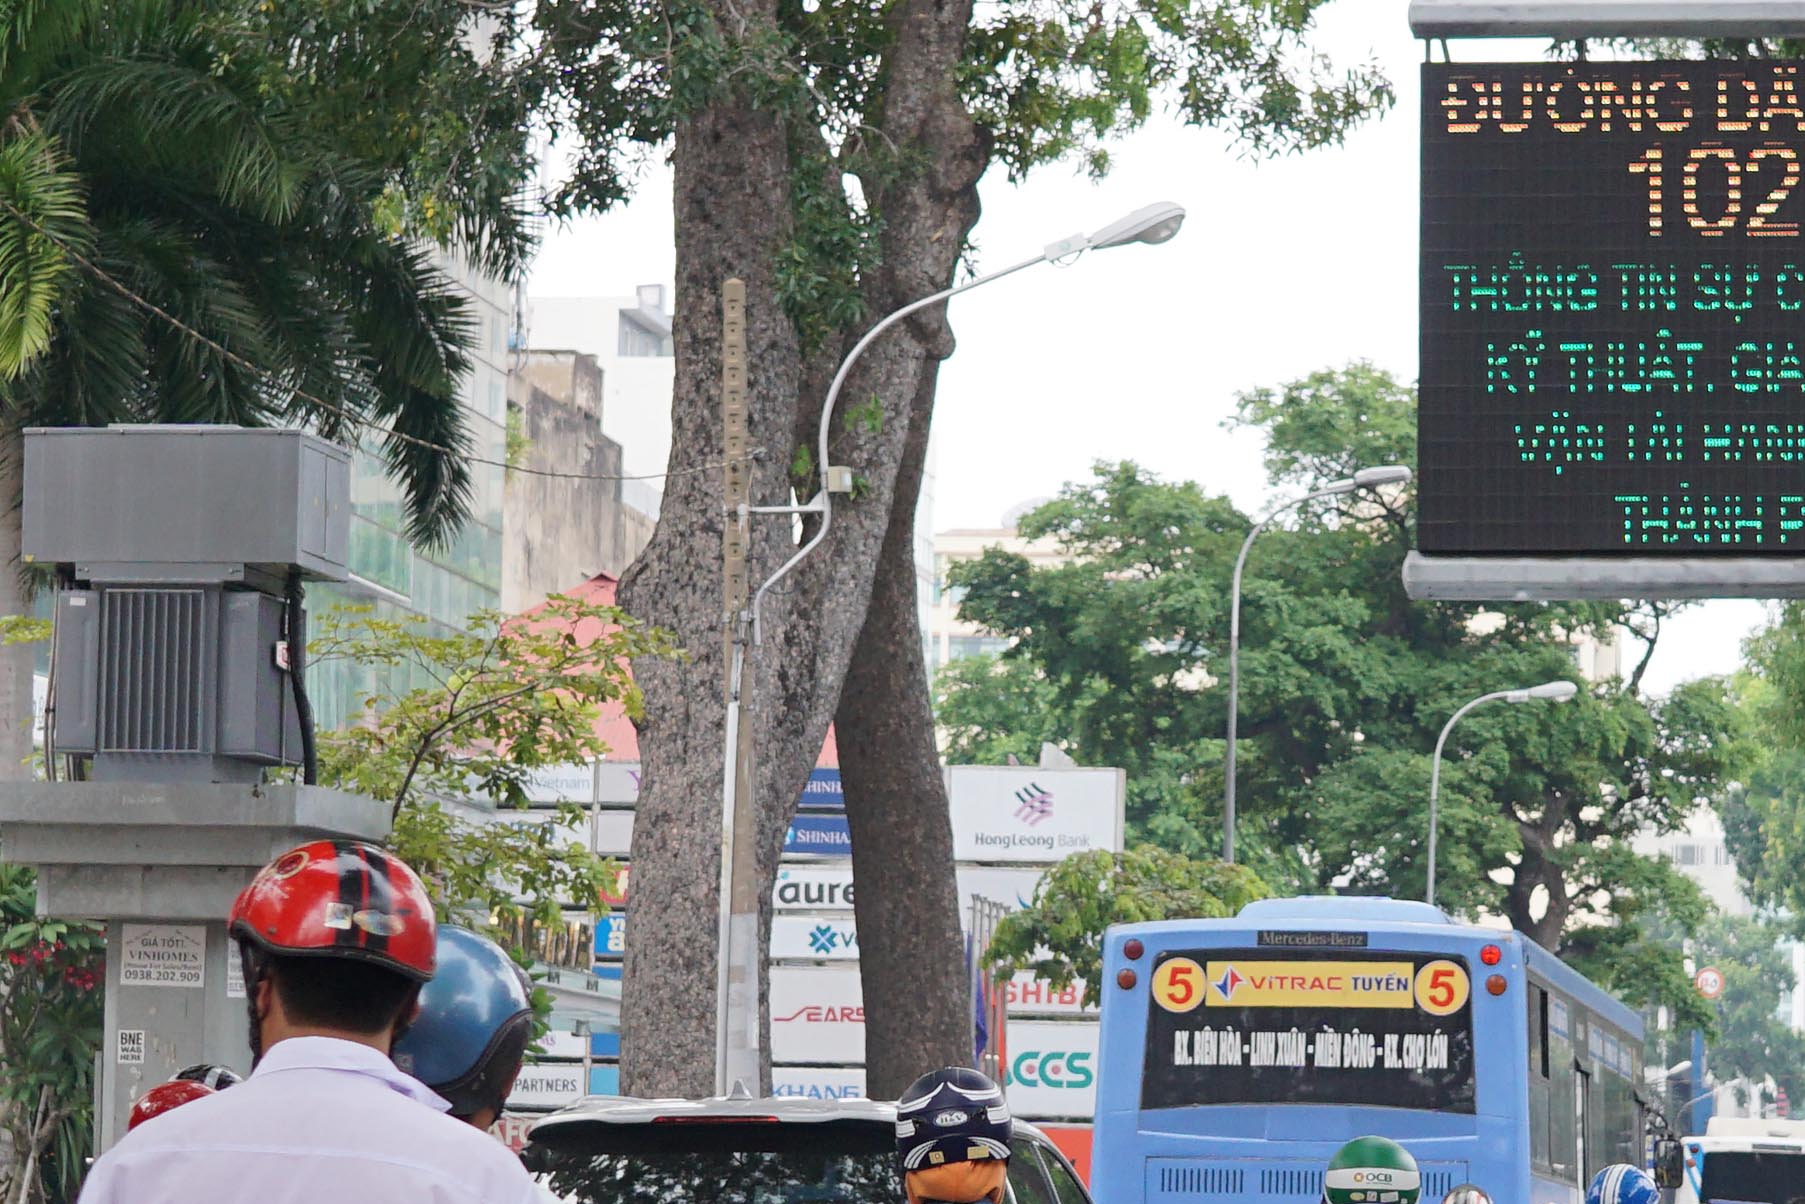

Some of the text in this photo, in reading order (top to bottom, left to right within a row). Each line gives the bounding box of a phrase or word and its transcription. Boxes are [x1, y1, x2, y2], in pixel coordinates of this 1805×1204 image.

[1612, 264, 1676, 311] TIN
[797, 829, 851, 844] SHINHA
[1058, 833, 1090, 847] Bank
[129, 950, 198, 961] VINHOMES
[124, 969, 200, 982] 0938.202.909
[1167, 966, 1193, 1004] 5
[1352, 972, 1408, 991] TUYẾN
[1428, 969, 1455, 1007] 5
[120, 1031, 142, 1046] BNE
[1006, 1051, 1093, 1089] CCS
[514, 1078, 577, 1092] PARTNERS
[1366, 1172, 1392, 1183] OCB
